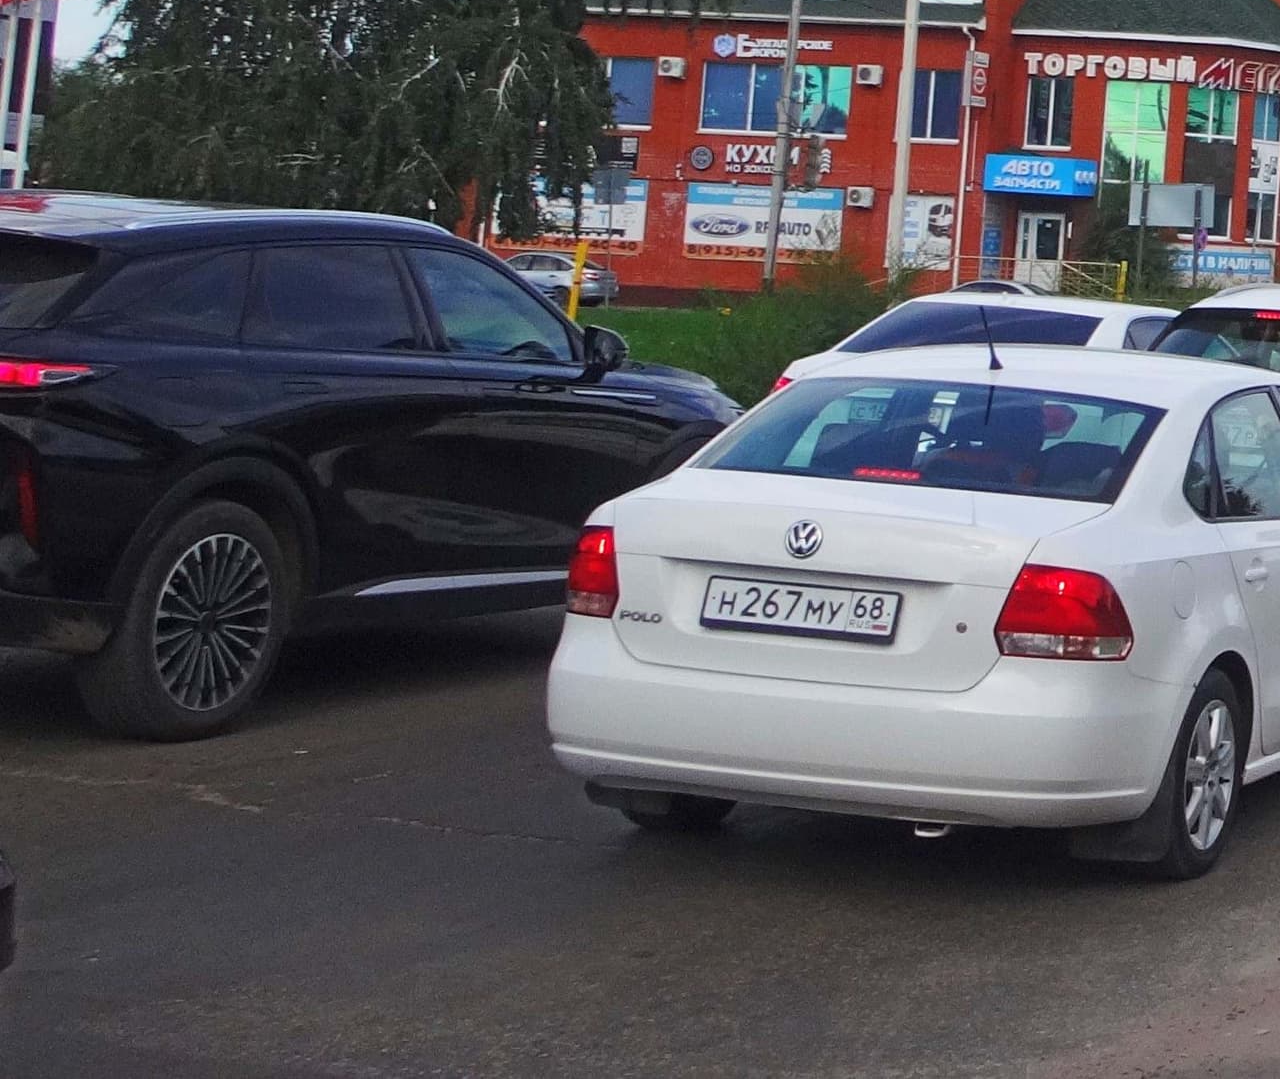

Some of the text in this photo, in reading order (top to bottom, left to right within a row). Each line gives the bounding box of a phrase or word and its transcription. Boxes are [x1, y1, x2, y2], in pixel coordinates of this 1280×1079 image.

[1024, 52, 1197, 83] ТОРГОВЫЙ
[1001, 160, 1055, 177] АВТО
[993, 176, 1062, 190] ЗАПЧАСТИ
[700, 215, 740, 234] Ford
[620, 609, 662, 623] POLO
[853, 595, 886, 619] 68
